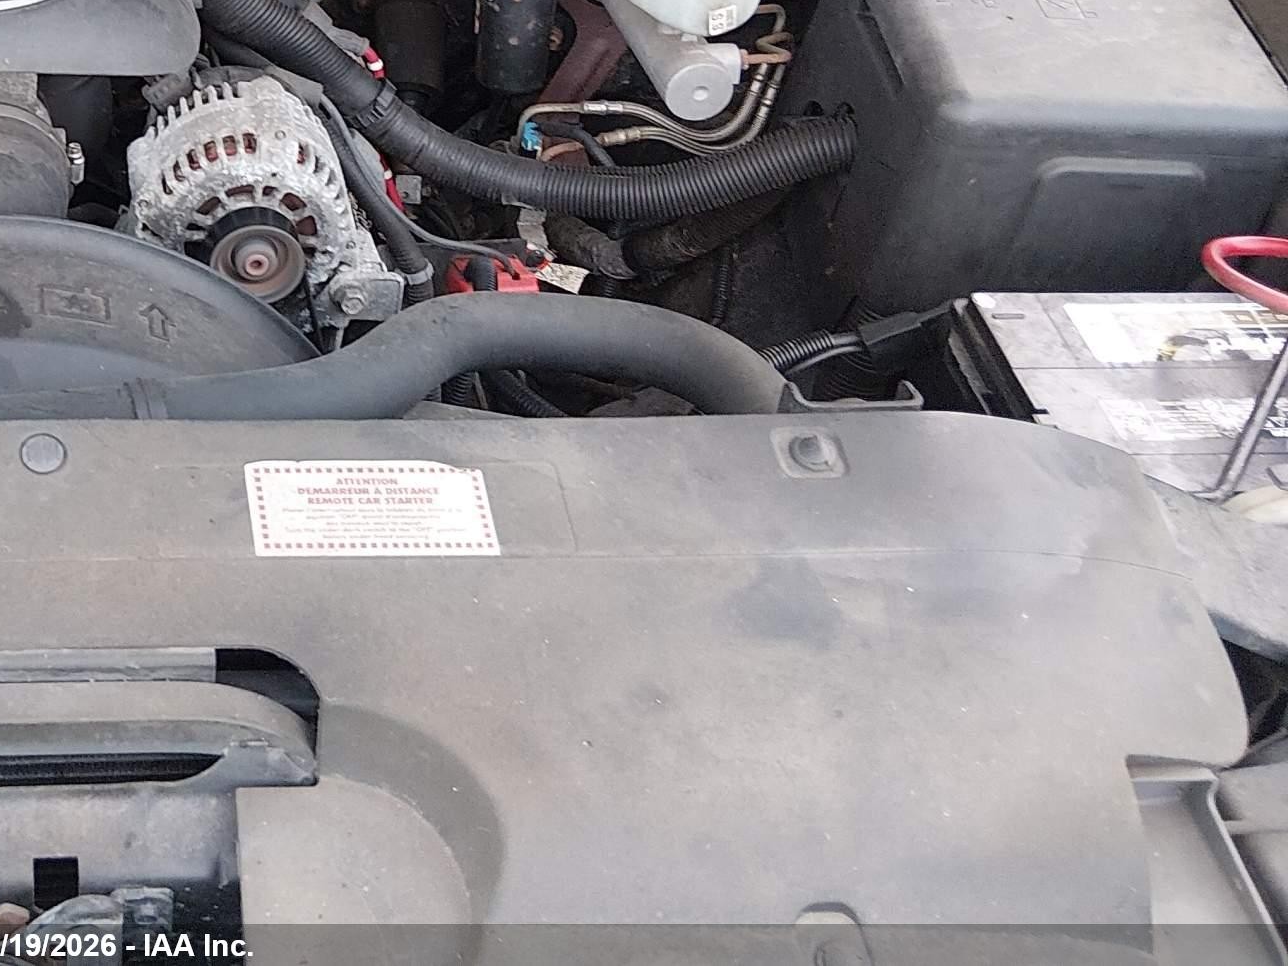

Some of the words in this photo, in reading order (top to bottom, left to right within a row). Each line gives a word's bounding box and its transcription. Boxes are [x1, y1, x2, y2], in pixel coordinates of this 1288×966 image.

[336, 477, 398, 486] ATTENTION
[386, 487, 439, 496] DISTANCE
[307, 497, 353, 505] REMOTE
[357, 497, 380, 505] CAR
[384, 497, 433, 505] STARTER
